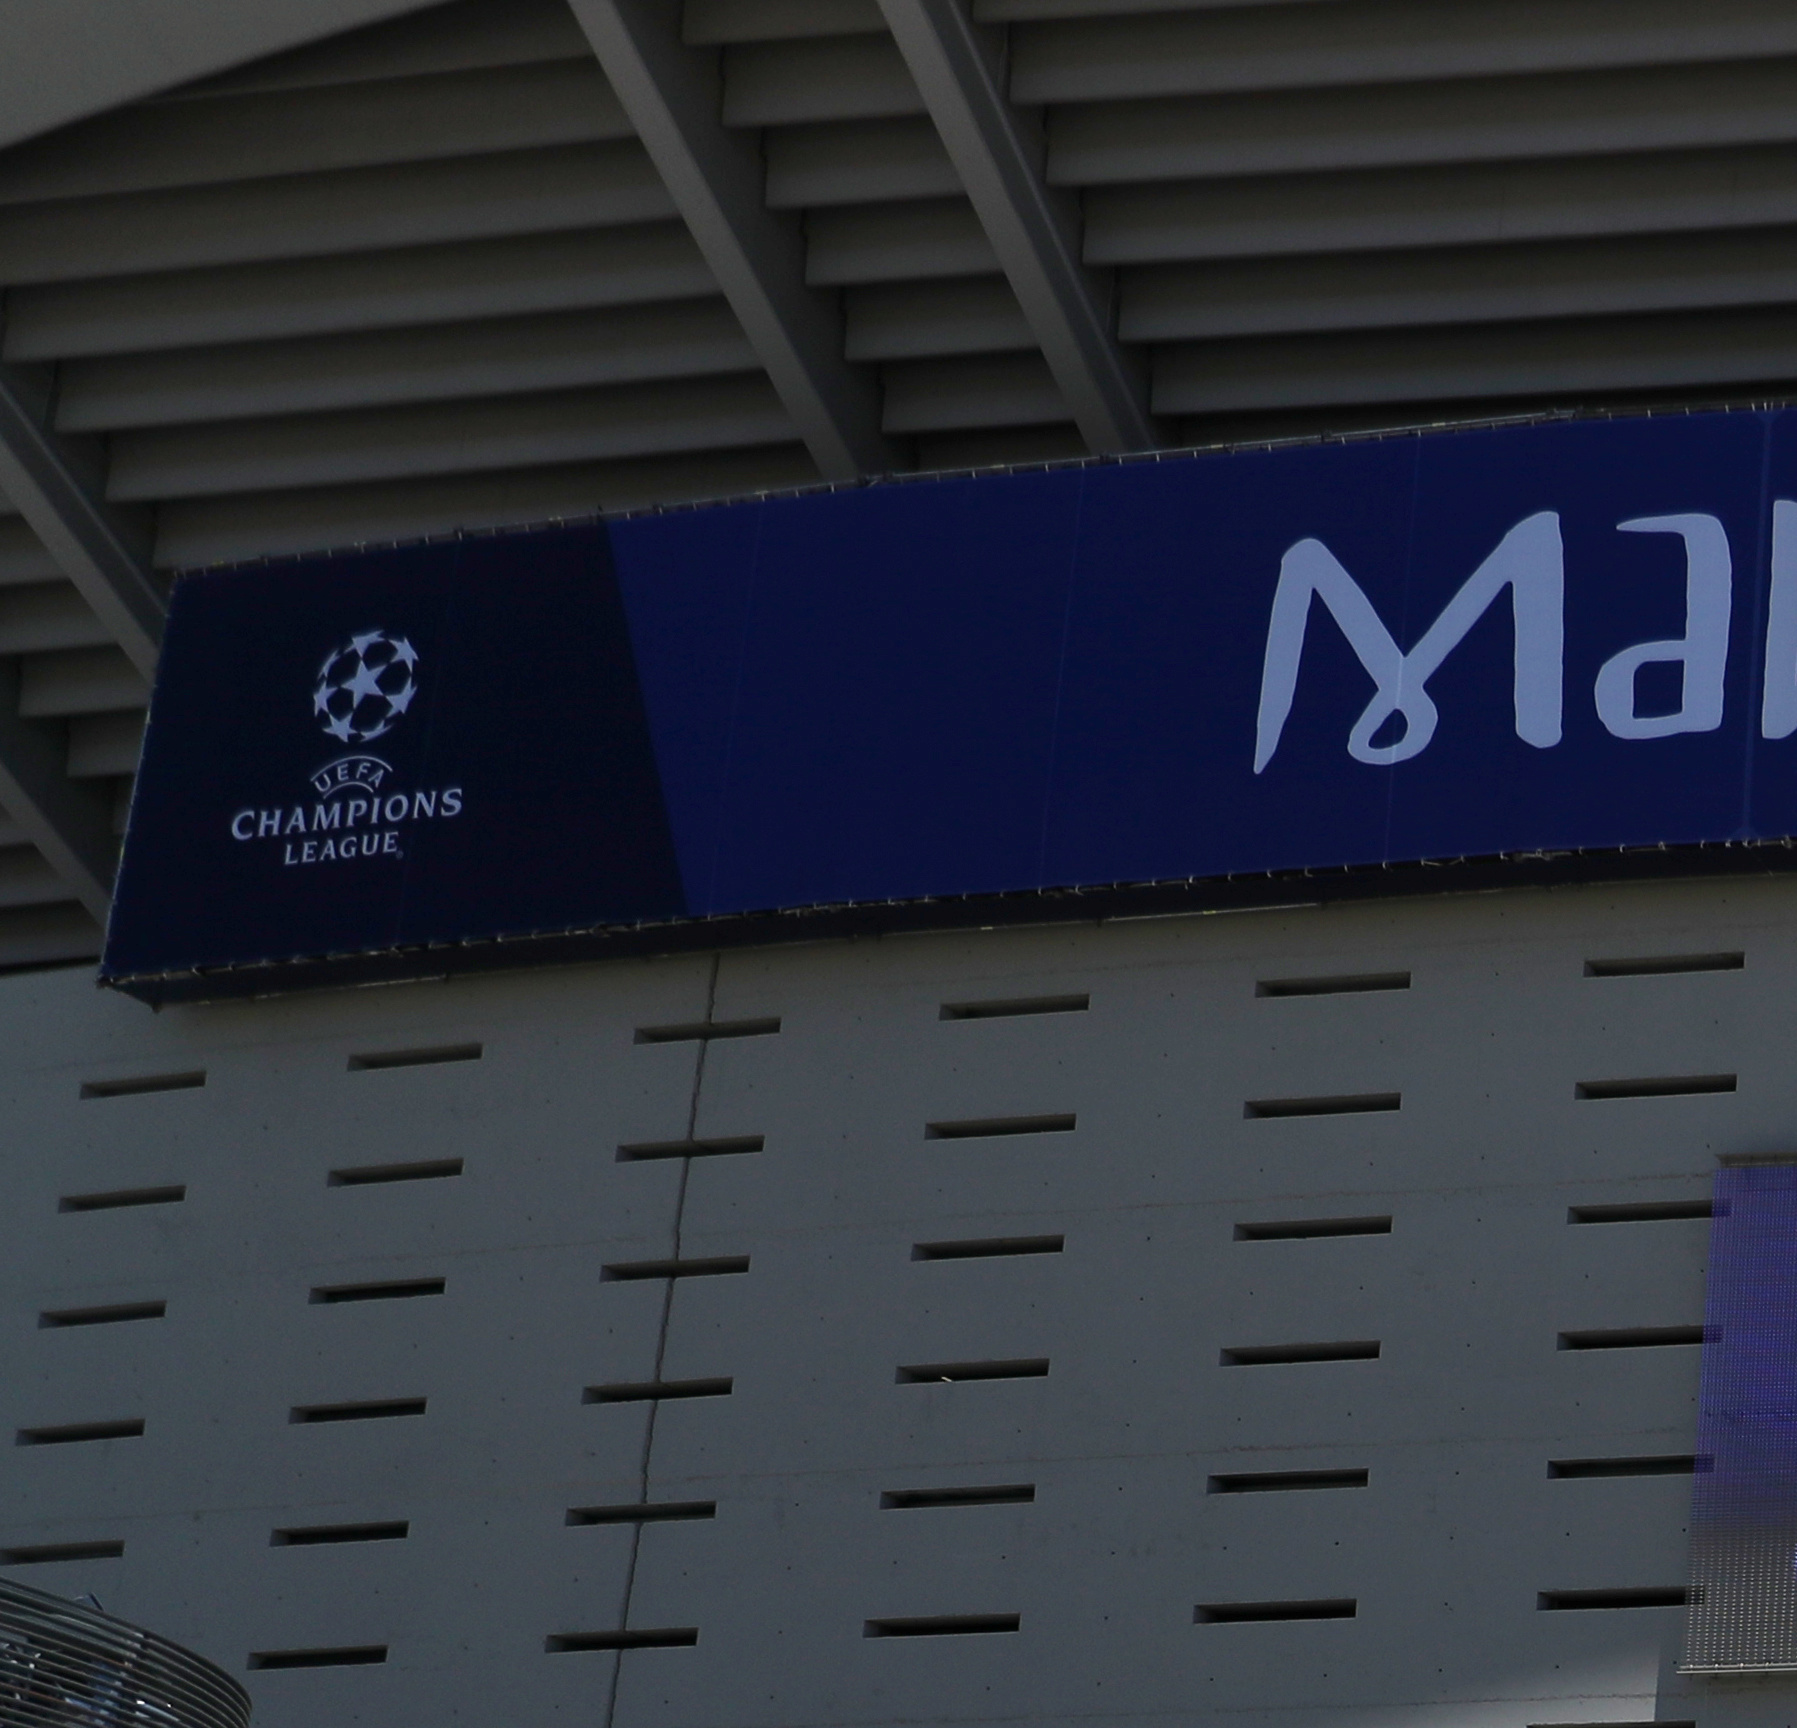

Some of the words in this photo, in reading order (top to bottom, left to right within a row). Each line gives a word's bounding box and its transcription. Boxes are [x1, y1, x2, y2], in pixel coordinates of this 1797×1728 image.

[314, 762, 385, 793] UEFA
[231, 788, 463, 841] CHAMPIONS
[284, 831, 400, 865] LEAGUE
